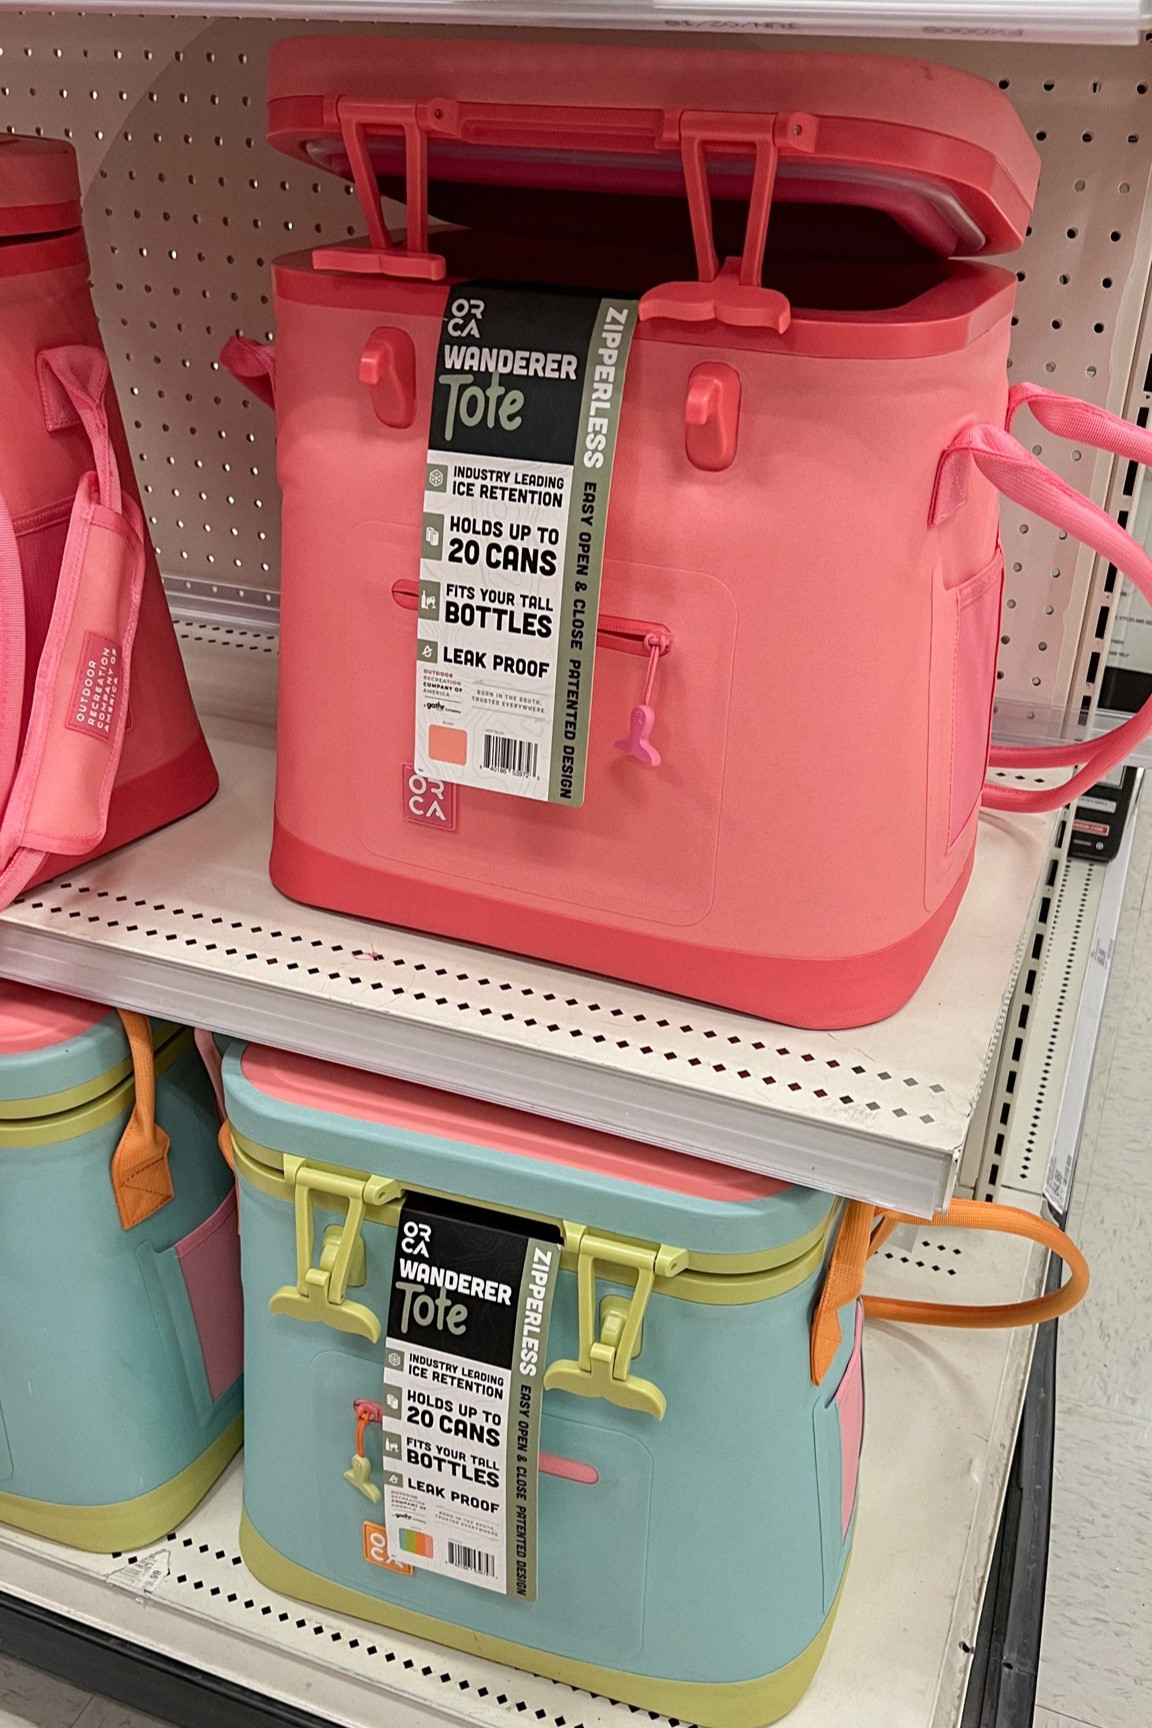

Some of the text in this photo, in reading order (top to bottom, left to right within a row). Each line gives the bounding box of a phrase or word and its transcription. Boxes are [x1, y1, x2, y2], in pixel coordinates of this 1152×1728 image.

[444, 345, 578, 380] WANDERER
[438, 369, 525, 441] Tote
[583, 306, 629, 469] ZIPPERLESS
[452, 481, 563, 508] ICE RETENTION
[453, 466, 565, 490] INDUSTRY LEADING
[449, 516, 559, 546] HOLDS UP TO
[448, 538, 557, 577] 20 CANS
[446, 583, 554, 612] FITS YOUR TALL
[444, 601, 553, 638] BOTTLES
[560, 481, 597, 799] EASY OPEN & CLOSE PATENTED DESIGN
[443, 646, 550, 678] LEAK PROOF
[76, 660, 97, 722] OUTDOOR
[88, 647, 110, 726] RECREATION
[97, 648, 117, 729] COMPANY OF
[104, 677, 119, 733] AMERICA
[423, 682, 453, 691] COMPANY
[399, 1258, 512, 1306] WANDERER
[395, 1281, 468, 1336] Tote
[519, 1247, 552, 1377] ZIPPERLESS
[408, 1364, 504, 1400] ICE RETENTION
[409, 1353, 504, 1386] INDUSTRY LEADING
[406, 1406, 500, 1447] 20 CANS
[407, 1390, 502, 1426] HOLDS UP TO
[406, 1437, 500, 1471] FITS YOUR TALL
[406, 1449, 500, 1488] BOTTLES
[408, 1478, 500, 1514] LEAK PROOF
[516, 1384, 532, 1596] EASY OPEN & CLOSE PATENTED DESIGN
